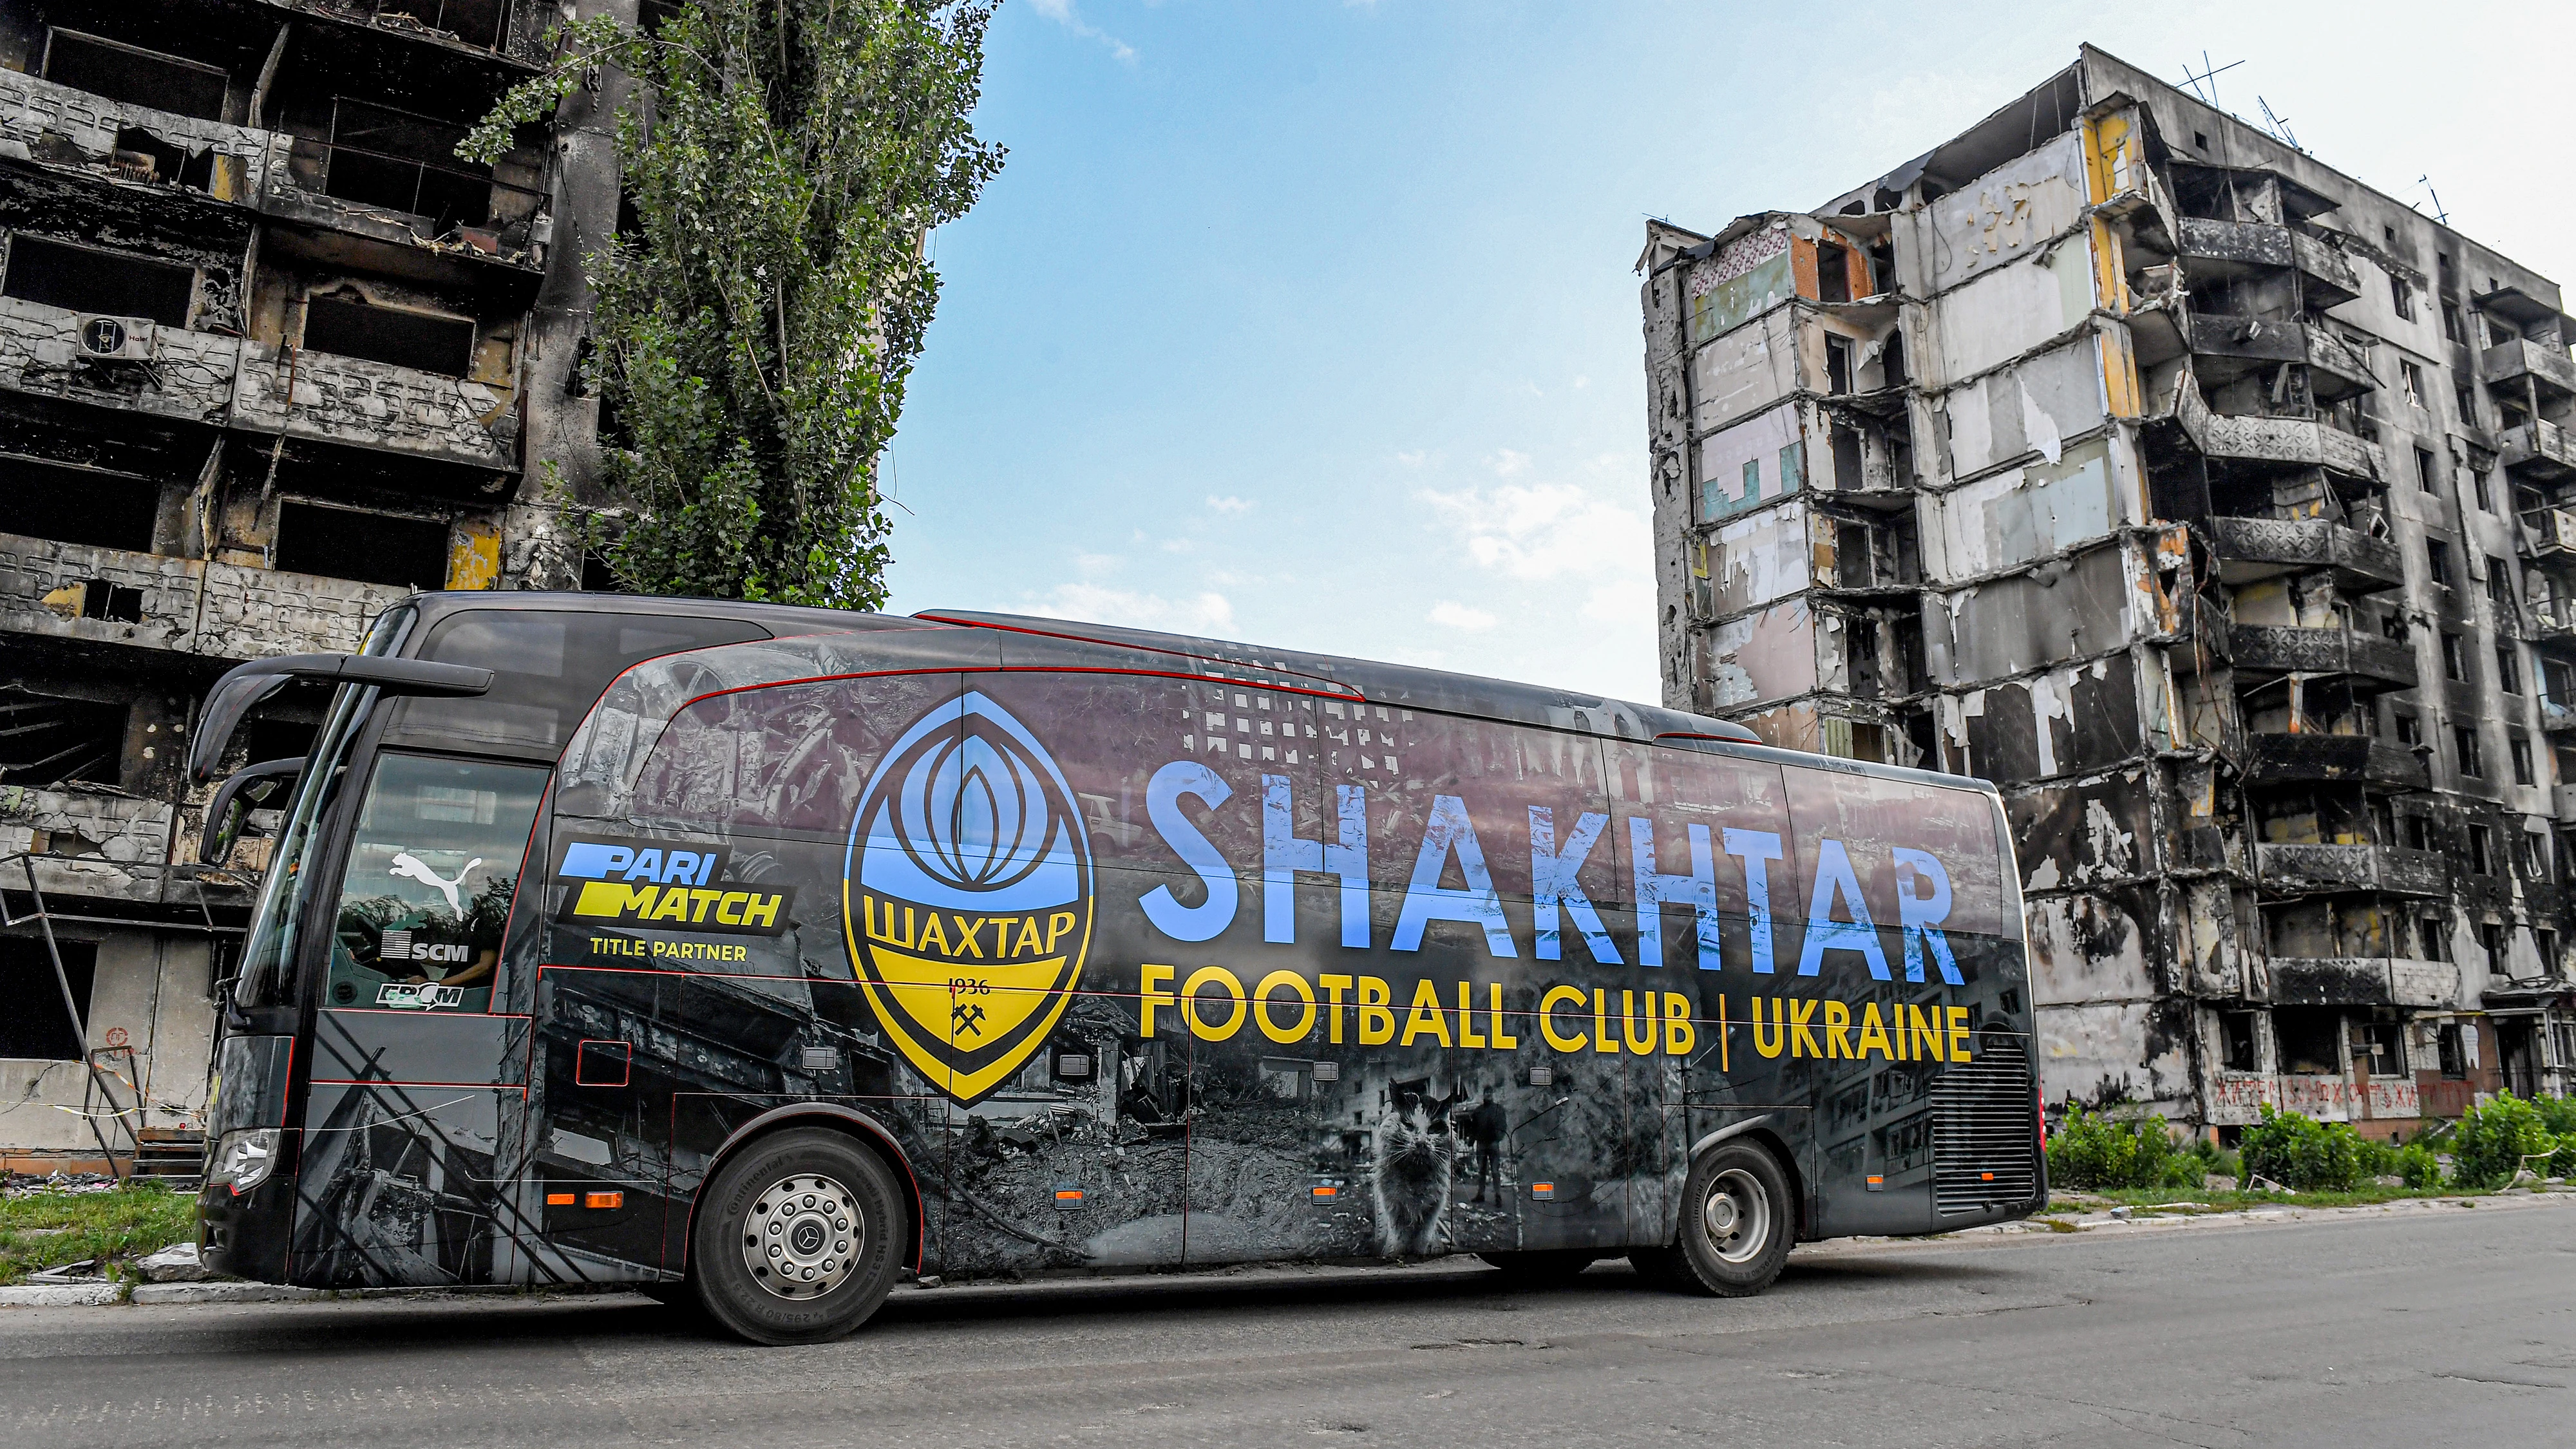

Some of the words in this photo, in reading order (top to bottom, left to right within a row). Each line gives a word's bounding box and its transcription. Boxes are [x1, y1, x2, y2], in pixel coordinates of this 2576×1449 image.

[558, 842, 717, 886] PARI
[1137, 759, 1965, 985] SHAKHTAR
[573, 881, 782, 927] MATCH
[863, 894, 1077, 960] ШАХТАР
[411, 942, 469, 962] SCM
[590, 937, 647, 957] TITLE
[652, 940, 747, 963] PARTNER
[947, 978, 991, 996] 1936
[1139, 963, 1517, 1050] FOOTBALL
[1539, 983, 1696, 1056] CLUB
[1750, 996, 1973, 1063] UKRAINE
